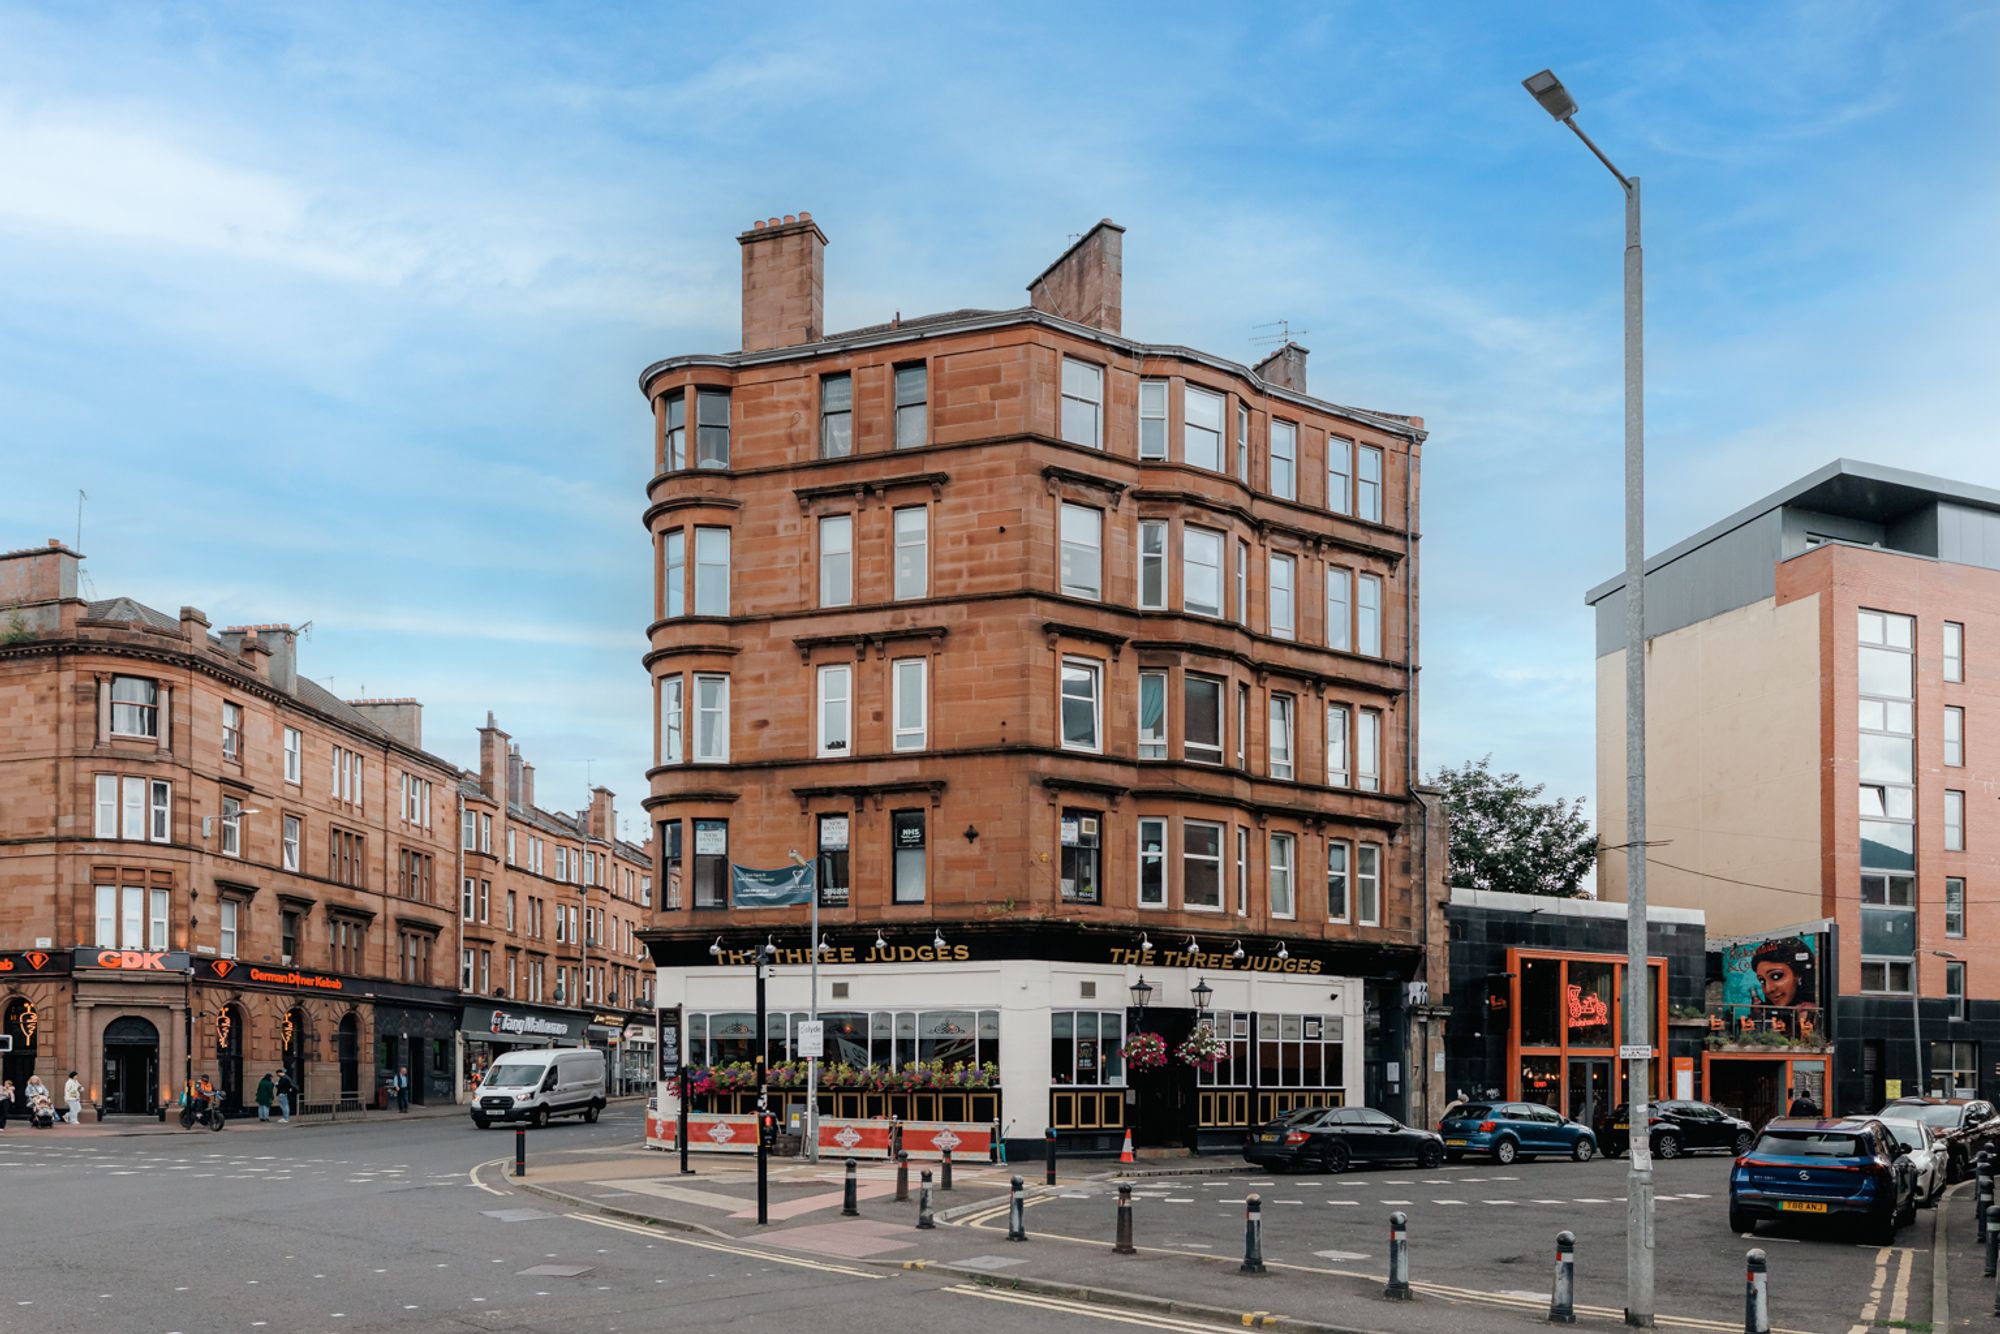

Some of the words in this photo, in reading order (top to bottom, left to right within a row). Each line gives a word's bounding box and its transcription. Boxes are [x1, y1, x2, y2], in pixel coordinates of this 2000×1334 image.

[97, 951, 166, 970] GDK
[864, 945, 970, 962] JUDGES
[1110, 948, 1156, 966] THE
[1163, 950, 1236, 970] THREE
[1240, 956, 1323, 974] JUDGES
[250, 968, 288, 984] German
[315, 976, 343, 990] Kebab
[502, 1013, 524, 1035] Tang
